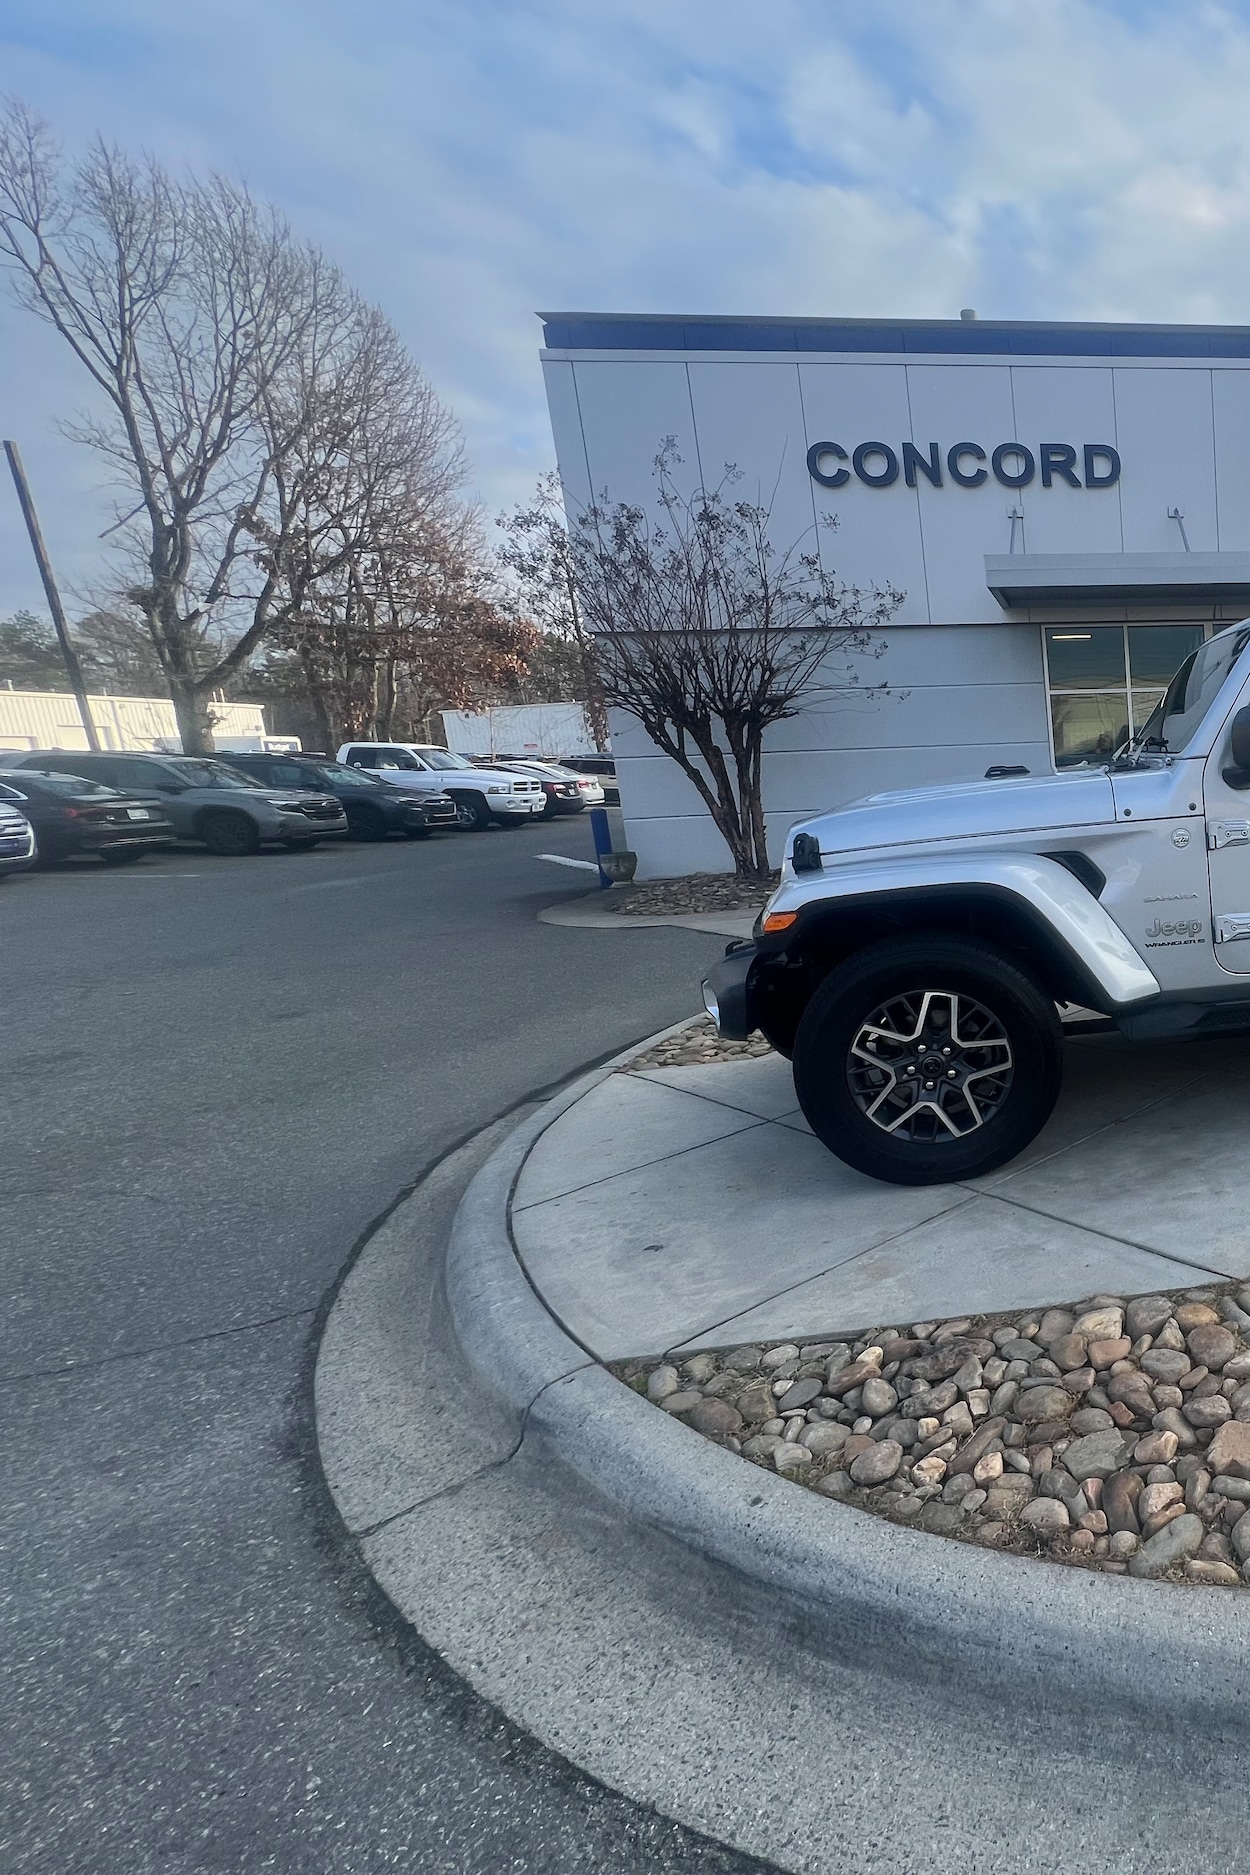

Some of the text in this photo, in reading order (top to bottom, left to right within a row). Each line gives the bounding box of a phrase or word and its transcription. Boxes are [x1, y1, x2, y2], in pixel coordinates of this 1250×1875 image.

[806, 441, 1121, 488] CONCORD
[1145, 918, 1202, 937] Jeep
[1145, 939, 1196, 948] WRANGLER
